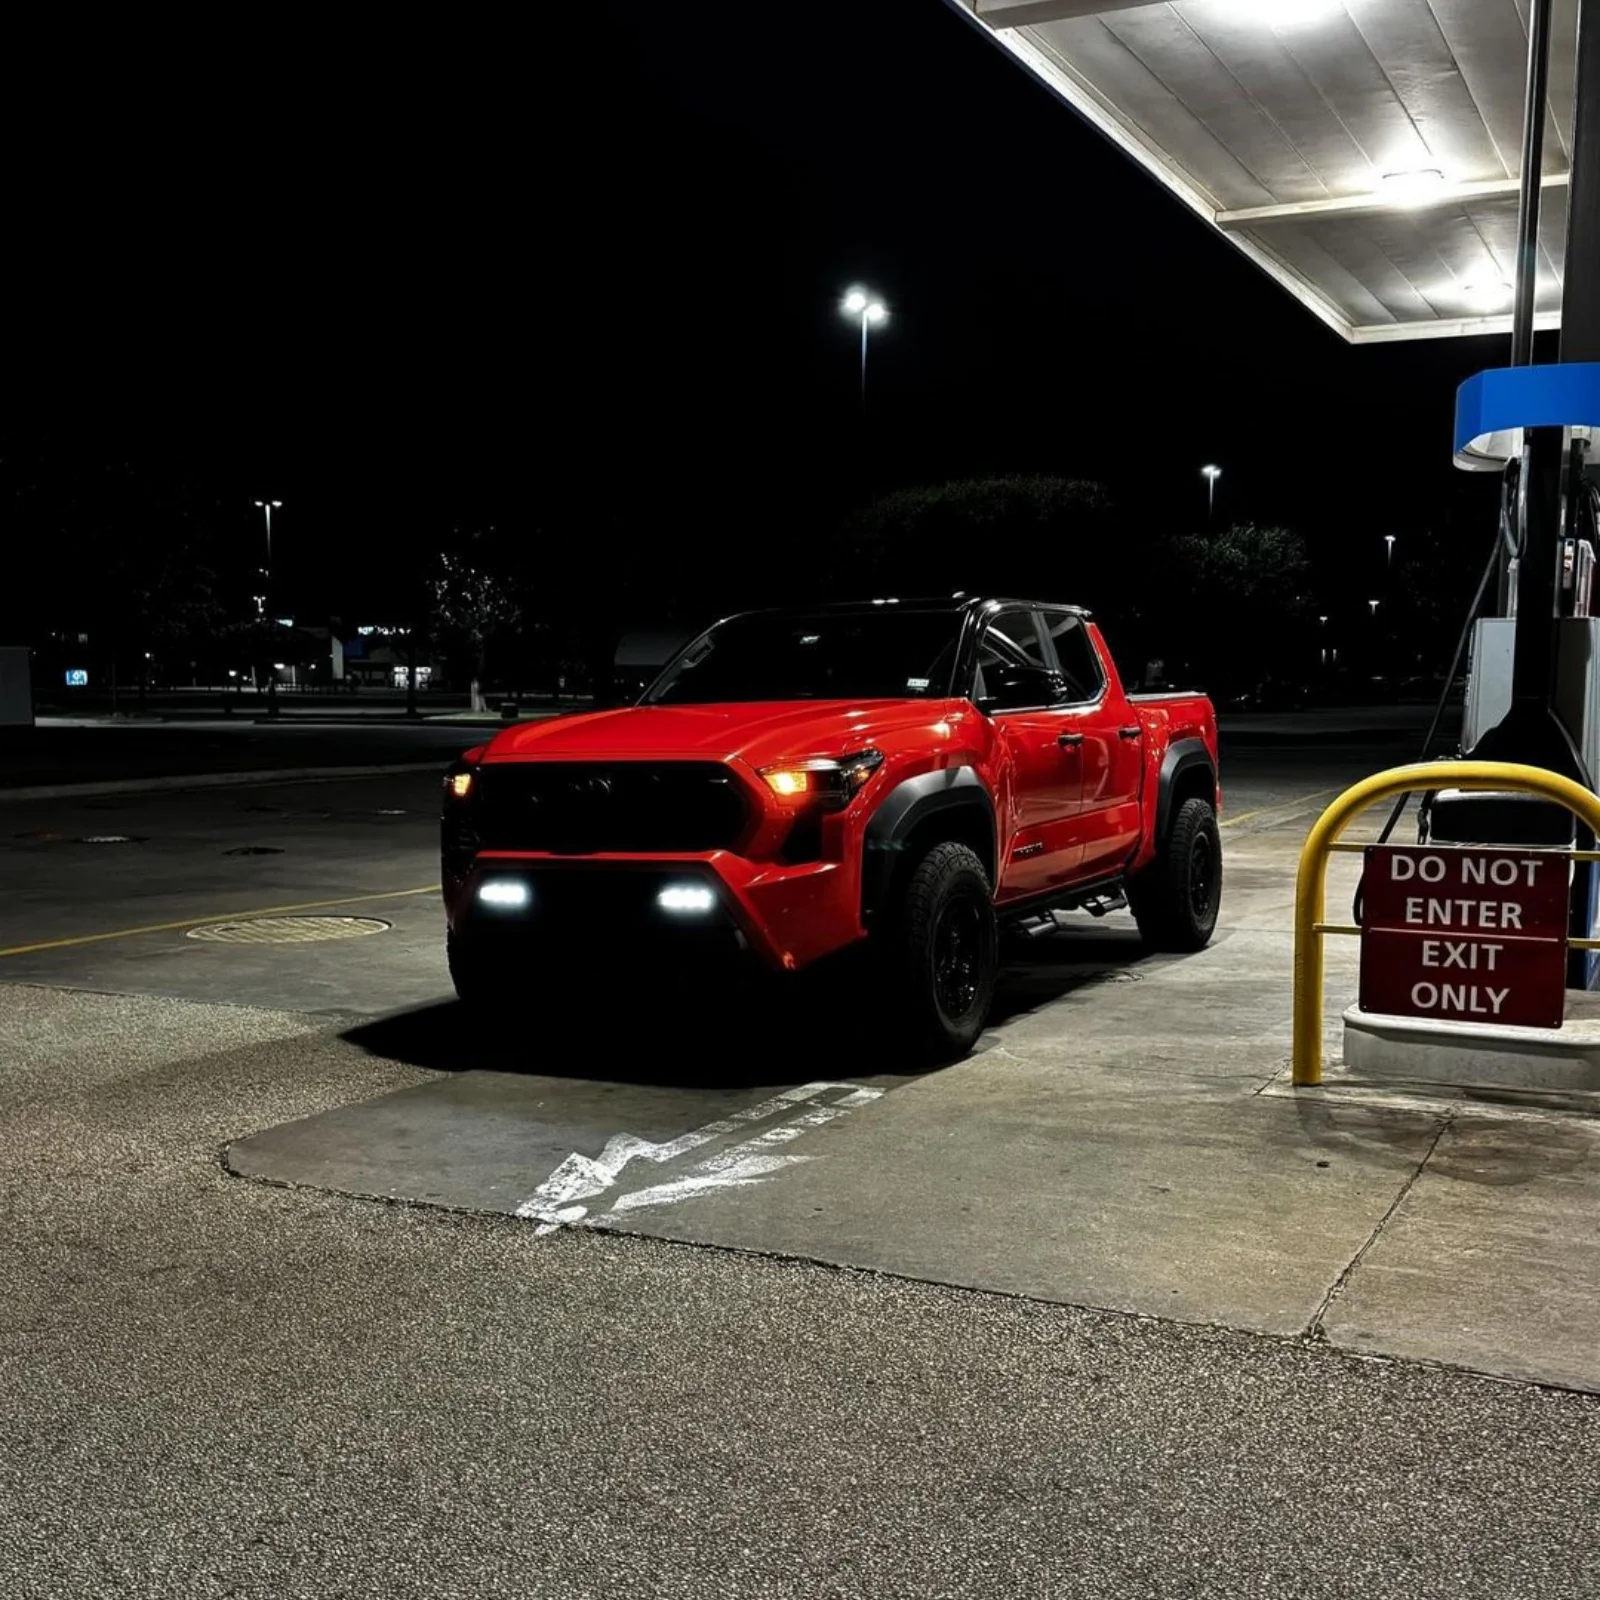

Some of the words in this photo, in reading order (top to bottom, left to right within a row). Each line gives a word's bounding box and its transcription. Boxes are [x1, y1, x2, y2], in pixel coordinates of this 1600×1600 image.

[1391, 855, 1447, 883] DO
[1461, 857, 1543, 888] NOT
[1405, 897, 1523, 929] ENTER
[1421, 940, 1504, 971] EXIT
[1411, 982, 1511, 1014] ONLY
